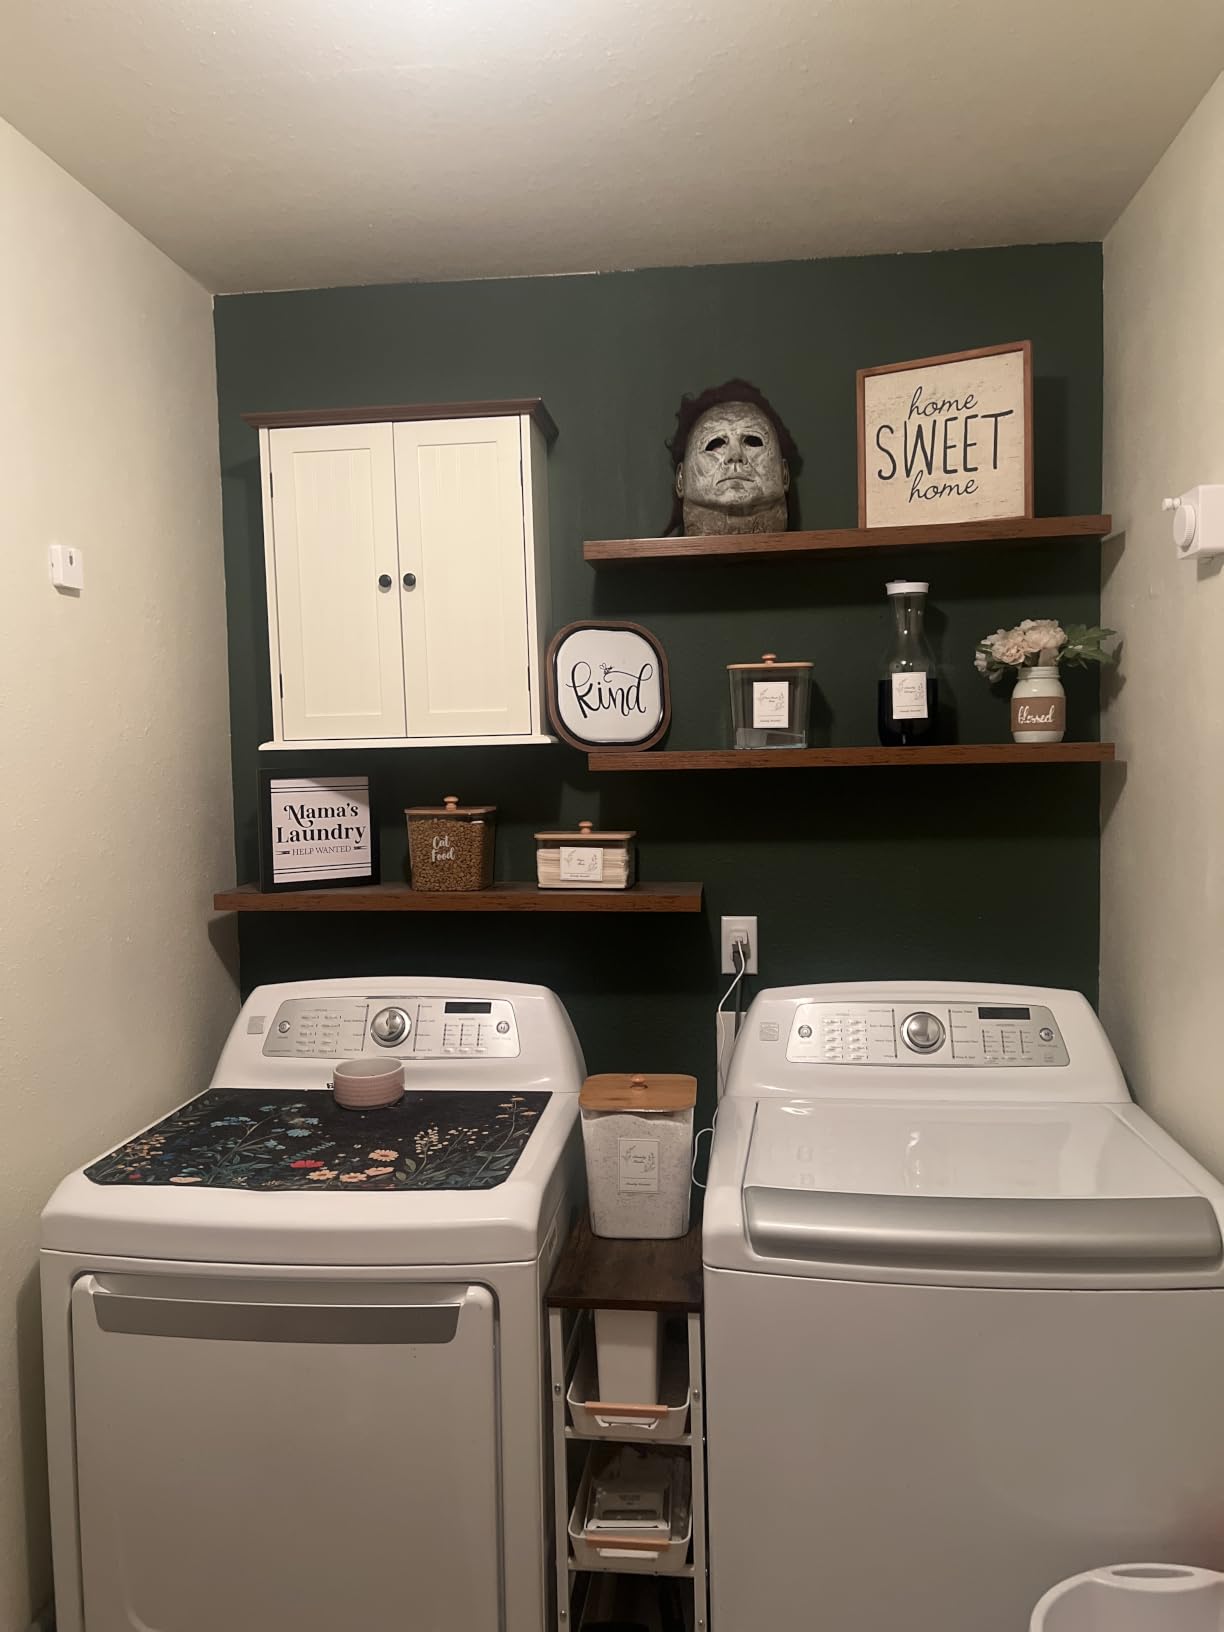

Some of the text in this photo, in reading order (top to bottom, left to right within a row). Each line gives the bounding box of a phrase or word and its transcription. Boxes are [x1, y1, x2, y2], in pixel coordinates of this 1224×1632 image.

[908, 386, 979, 420] home
[876, 409, 1014, 480] SWEET
[908, 469, 979, 504] home
[565, 661, 654, 718] kind
[283, 802, 359, 828] Mama's
[276, 824, 367, 844] Laundry
[432, 835, 450, 849] Cat
[292, 845, 352, 856] HELP WANTED
[431, 847, 456, 862] Food
